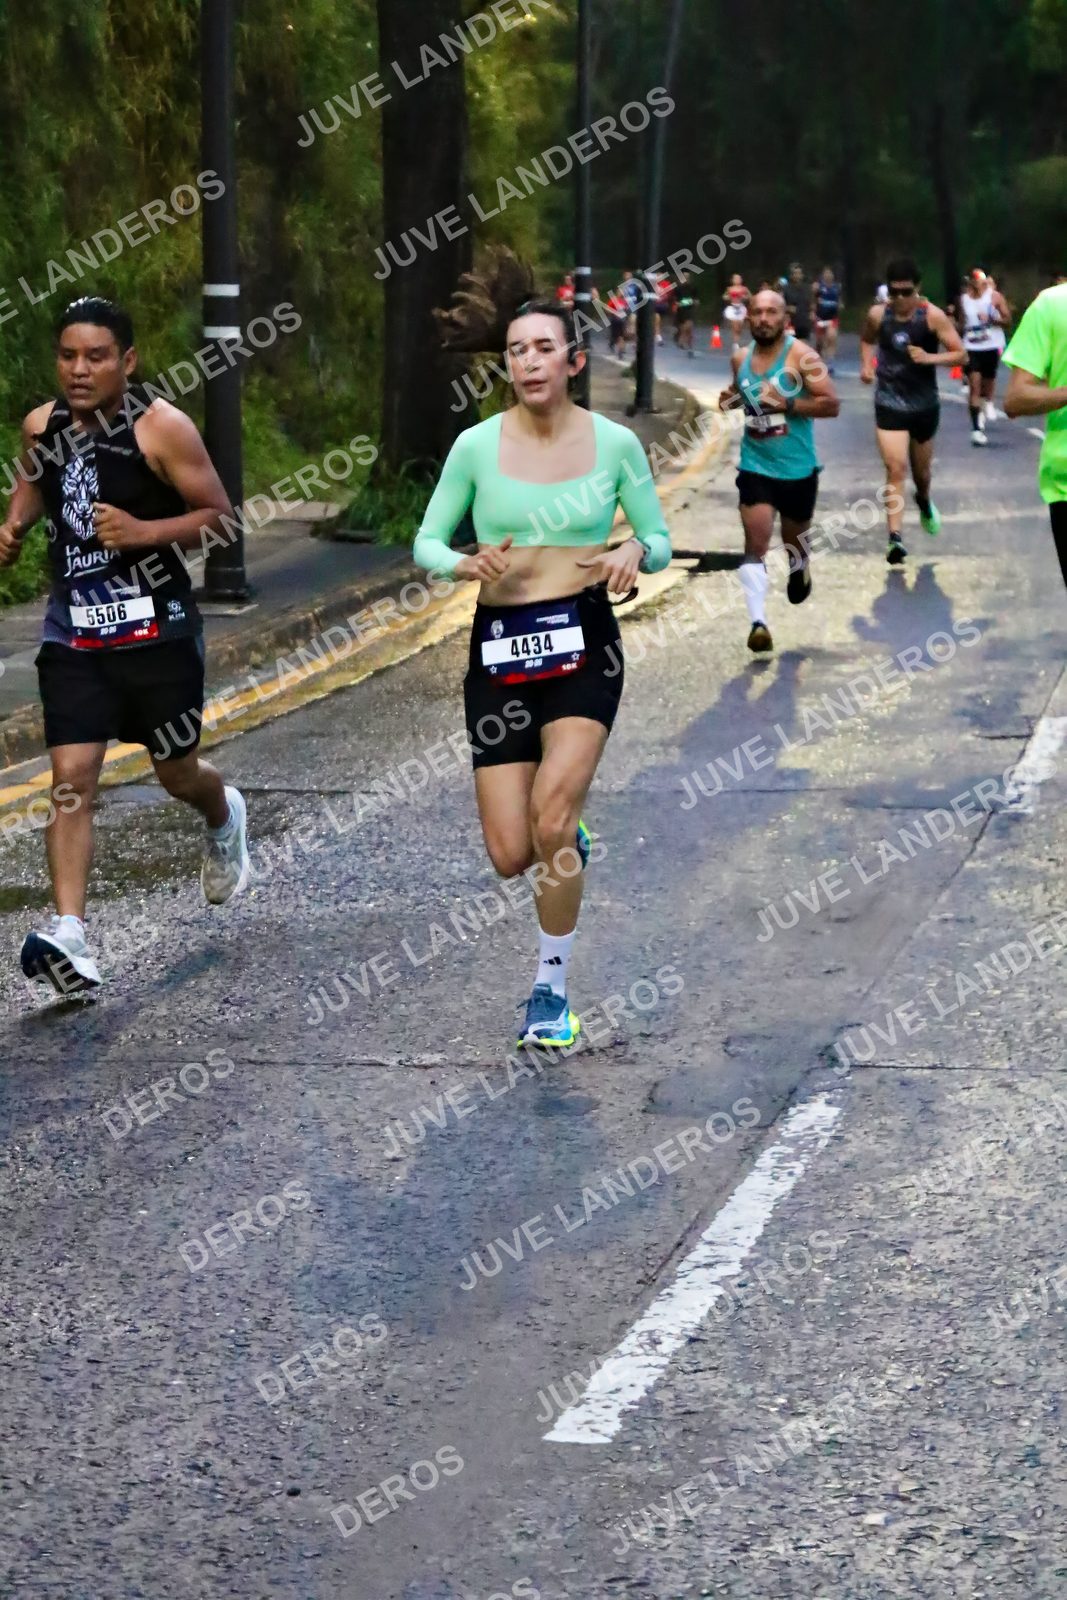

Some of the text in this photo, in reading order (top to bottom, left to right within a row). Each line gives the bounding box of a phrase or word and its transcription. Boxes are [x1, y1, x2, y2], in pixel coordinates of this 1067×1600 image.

[66, 544, 82, 557] LA
[86, 603, 127, 626] 5506
[510, 633, 554, 658] 4434
